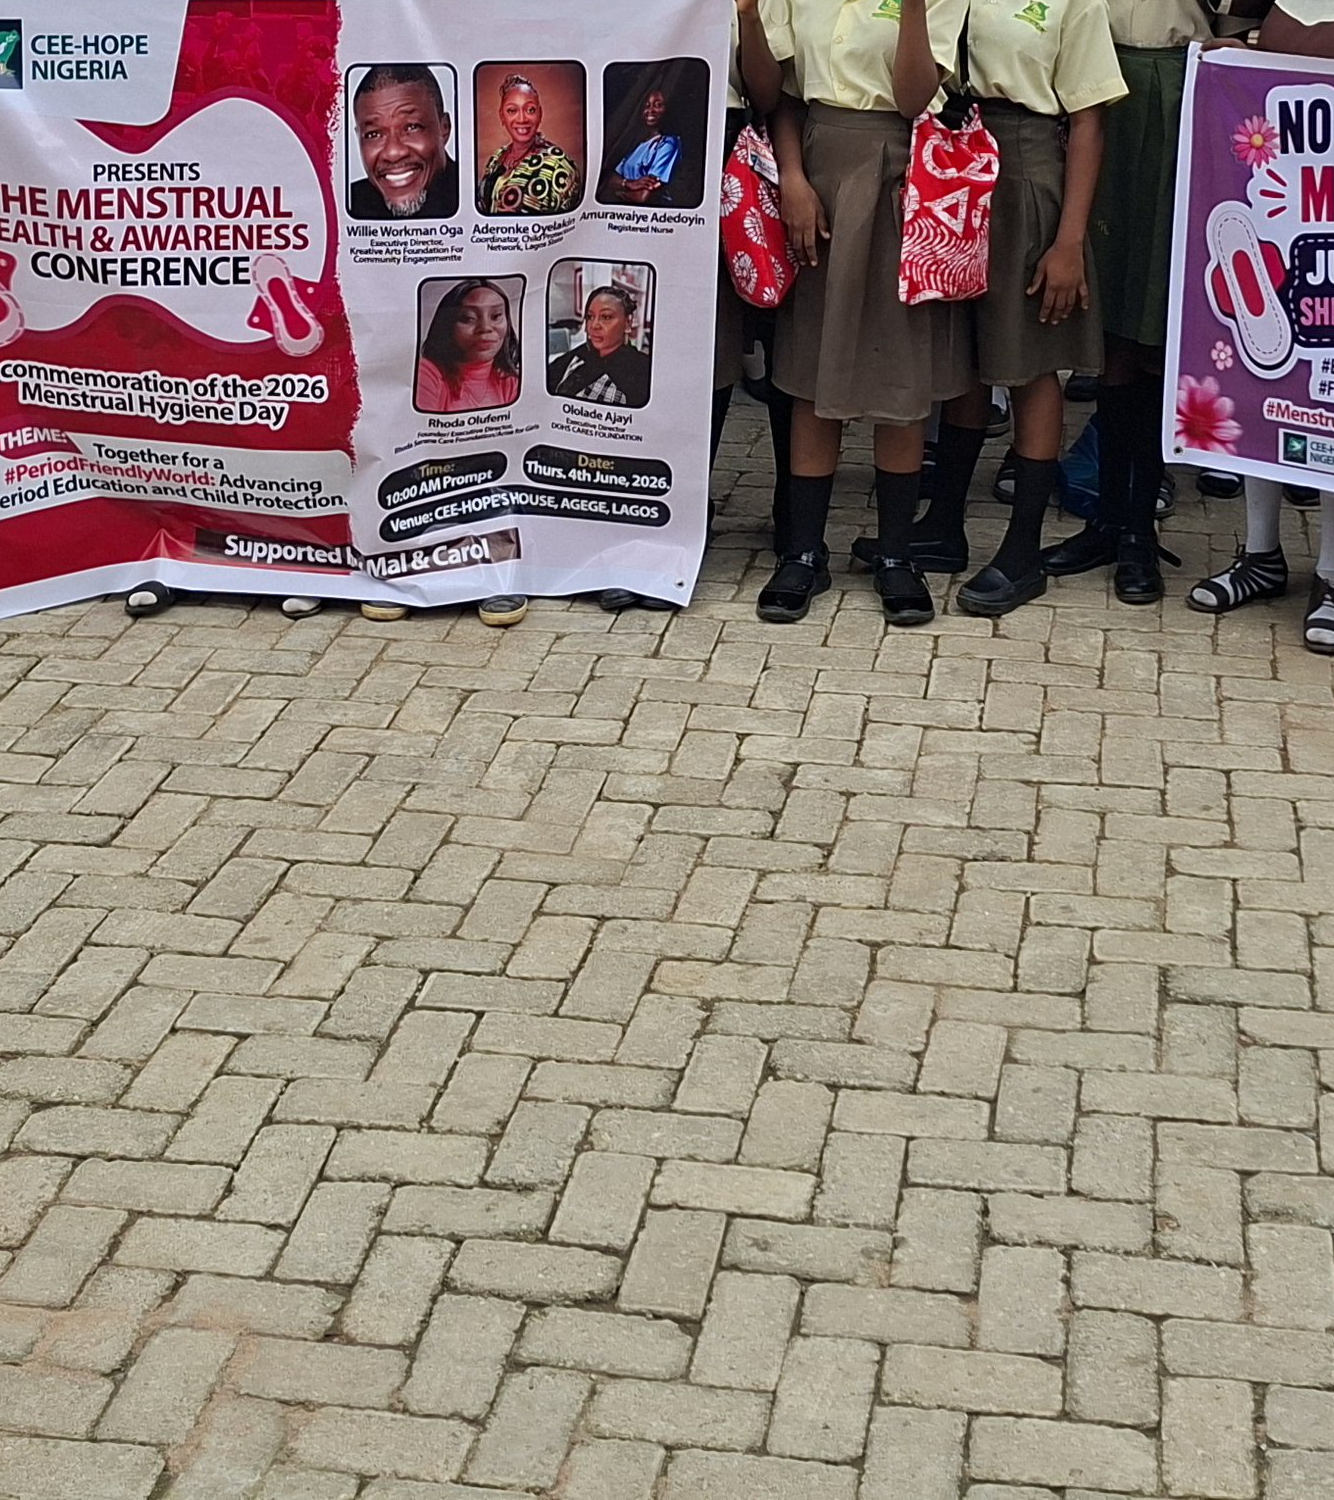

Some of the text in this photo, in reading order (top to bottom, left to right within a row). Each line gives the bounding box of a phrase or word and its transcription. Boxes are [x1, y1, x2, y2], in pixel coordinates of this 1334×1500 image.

[30, 35, 148, 55] CEE-HOPE
[31, 60, 129, 81] NIGERIA
[1277, 98, 1332, 156] NO
[93, 162, 201, 182] PRESENTS
[57, 186, 294, 220] MENSTRUAL
[346, 225, 465, 239] Willie Workman Oga
[472, 223, 530, 236] Aderonke
[579, 210, 706, 227] Amurawaiye Adedoyin
[90, 226, 114, 252] &
[119, 224, 310, 252] AWARENESS
[30, 251, 252, 287] CONFERENCE
[0, 361, 190, 397] commemoration
[193, 375, 220, 398] of
[221, 376, 263, 399] the
[267, 377, 325, 400] 2026
[21, 381, 287, 428] Menstrual Hygiene Day
[562, 403, 634, 426] Ololade Ajayi
[428, 411, 512, 429] Rhoda Olufemi
[92, 442, 225, 471] Together for a
[419, 462, 456, 479] Time:
[578, 454, 615, 471] Date:
[4, 456, 323, 496] #PeriodFriendlyWorld: Advancing
[385, 468, 494, 508] 10:00 AM Prompt
[525, 460, 671, 491] Thurs. 4th June, 2026.
[53, 473, 148, 497] Education
[151, 482, 189, 500] and
[190, 485, 239, 506] Child
[242, 492, 349, 511] Protection.
[389, 491, 659, 534] Venue: CEE-HOPE'S HOUSE, AGEGE, LAGOS
[224, 534, 491, 579] Supported Mal & Carol
